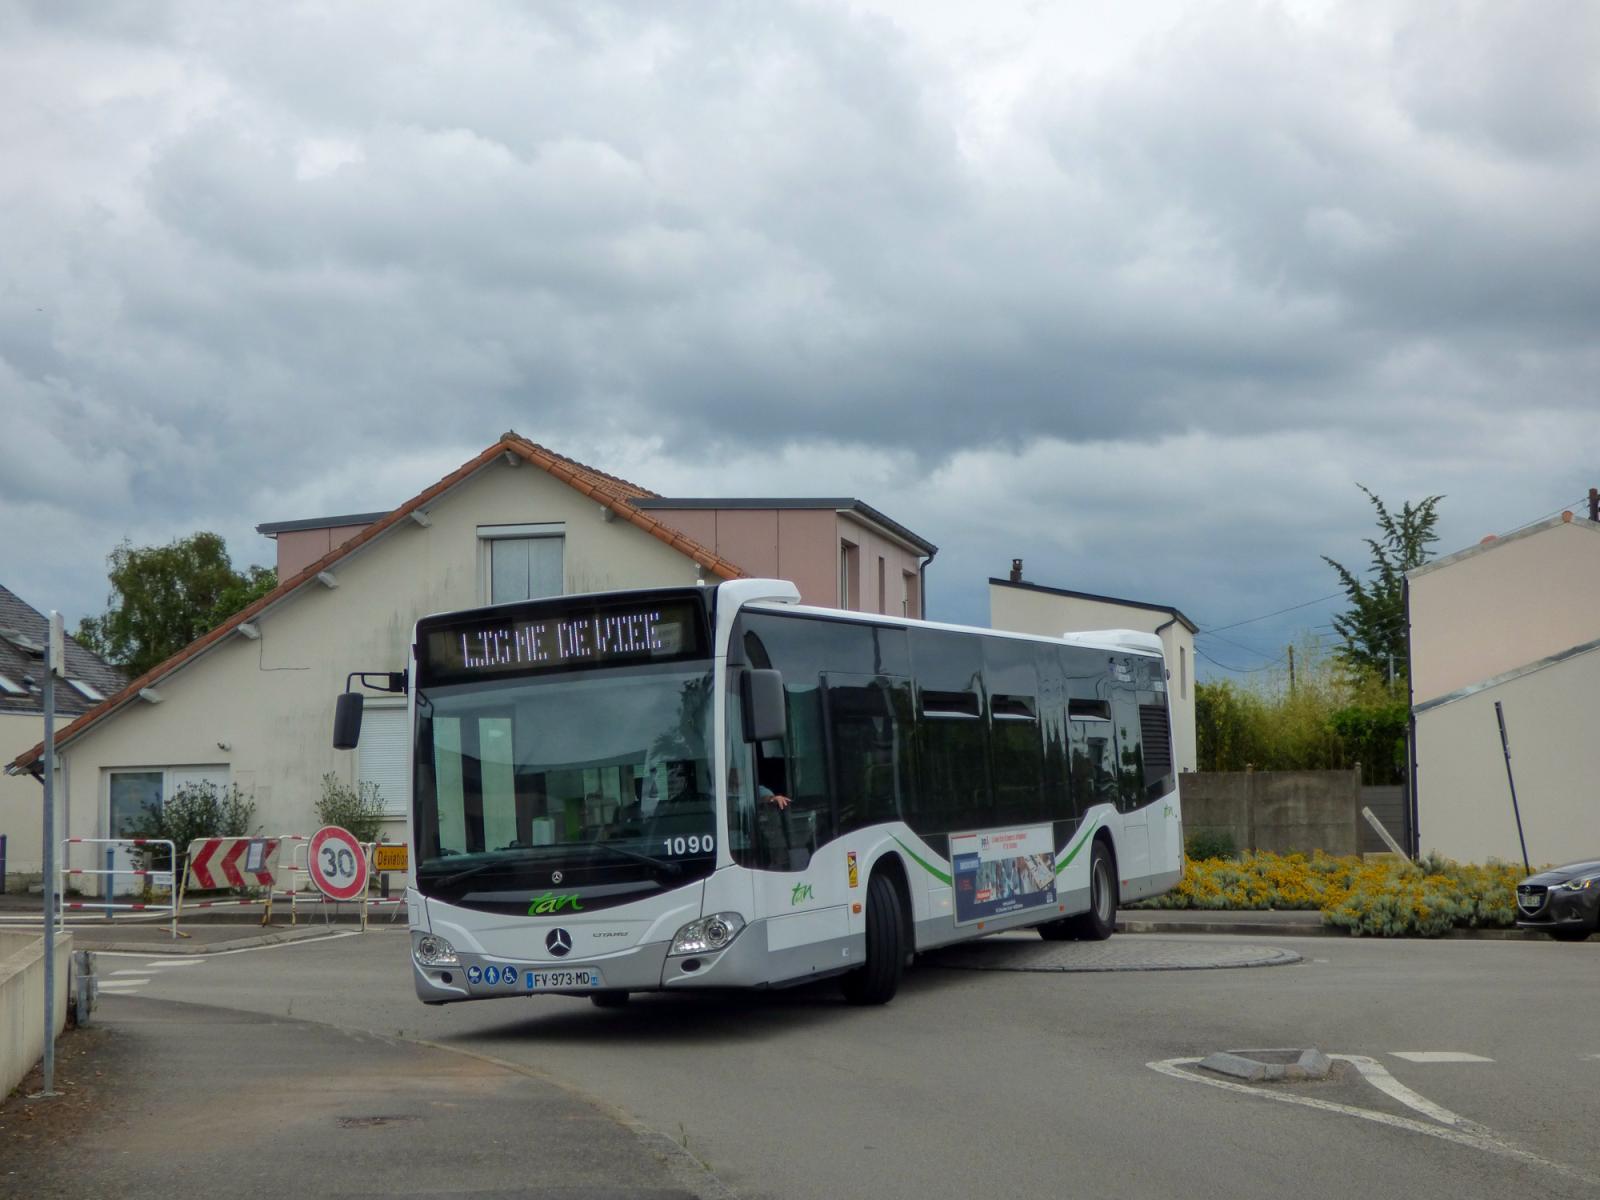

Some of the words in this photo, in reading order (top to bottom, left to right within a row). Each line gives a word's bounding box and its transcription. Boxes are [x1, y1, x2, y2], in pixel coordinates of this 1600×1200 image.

[664, 834, 714, 856] 1090
[321, 847, 354, 878] 30
[527, 892, 585, 916] tan
